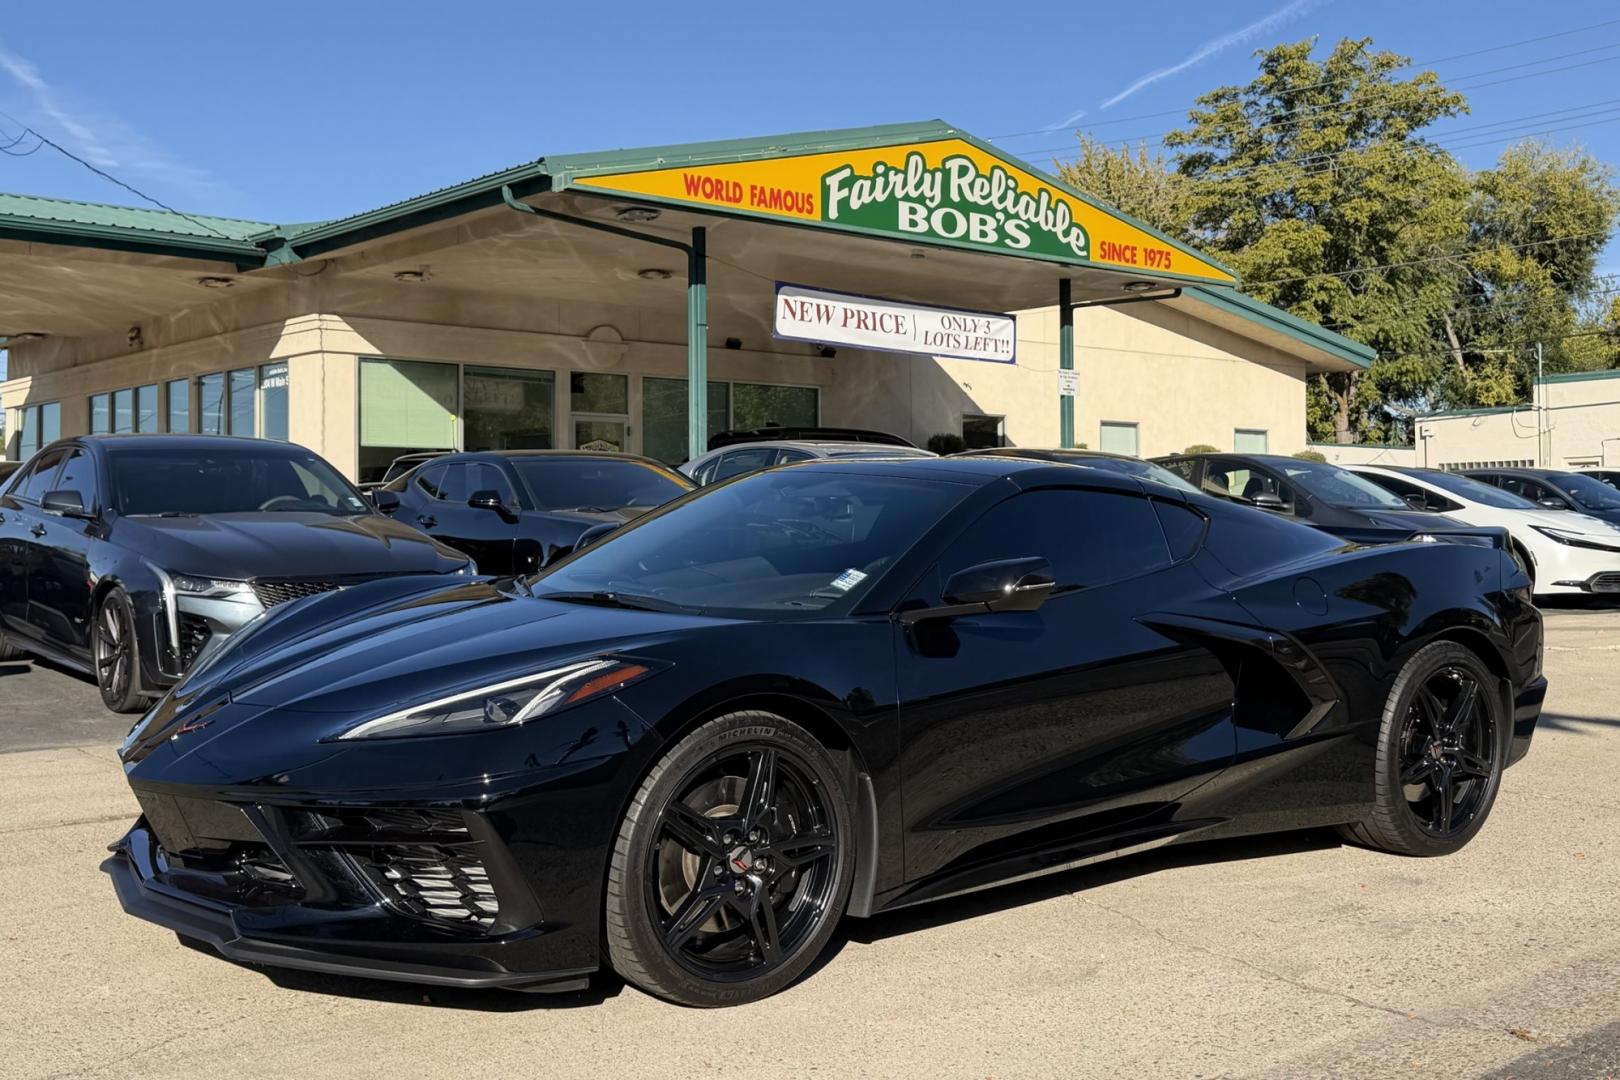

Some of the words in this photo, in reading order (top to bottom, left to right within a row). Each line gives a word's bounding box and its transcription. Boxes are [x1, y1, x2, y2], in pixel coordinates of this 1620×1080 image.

[683, 173, 743, 204] WORLD
[750, 184, 814, 215] FAMOUS
[826, 154, 941, 220] Fairly
[945, 158, 1088, 257] Reliable
[898, 200, 1031, 249] BOB'S
[1100, 240, 1137, 265] SINCE
[1143, 247, 1172, 270] 1975
[782, 298, 835, 326] NEW
[841, 307, 906, 335] PRICE
[941, 314, 980, 332] ONLY
[983, 320, 991, 334] 3
[923, 330, 961, 350] LOTS
[963, 334, 1010, 354] LEFT!!
[719, 727, 773, 740] MICHELIN
